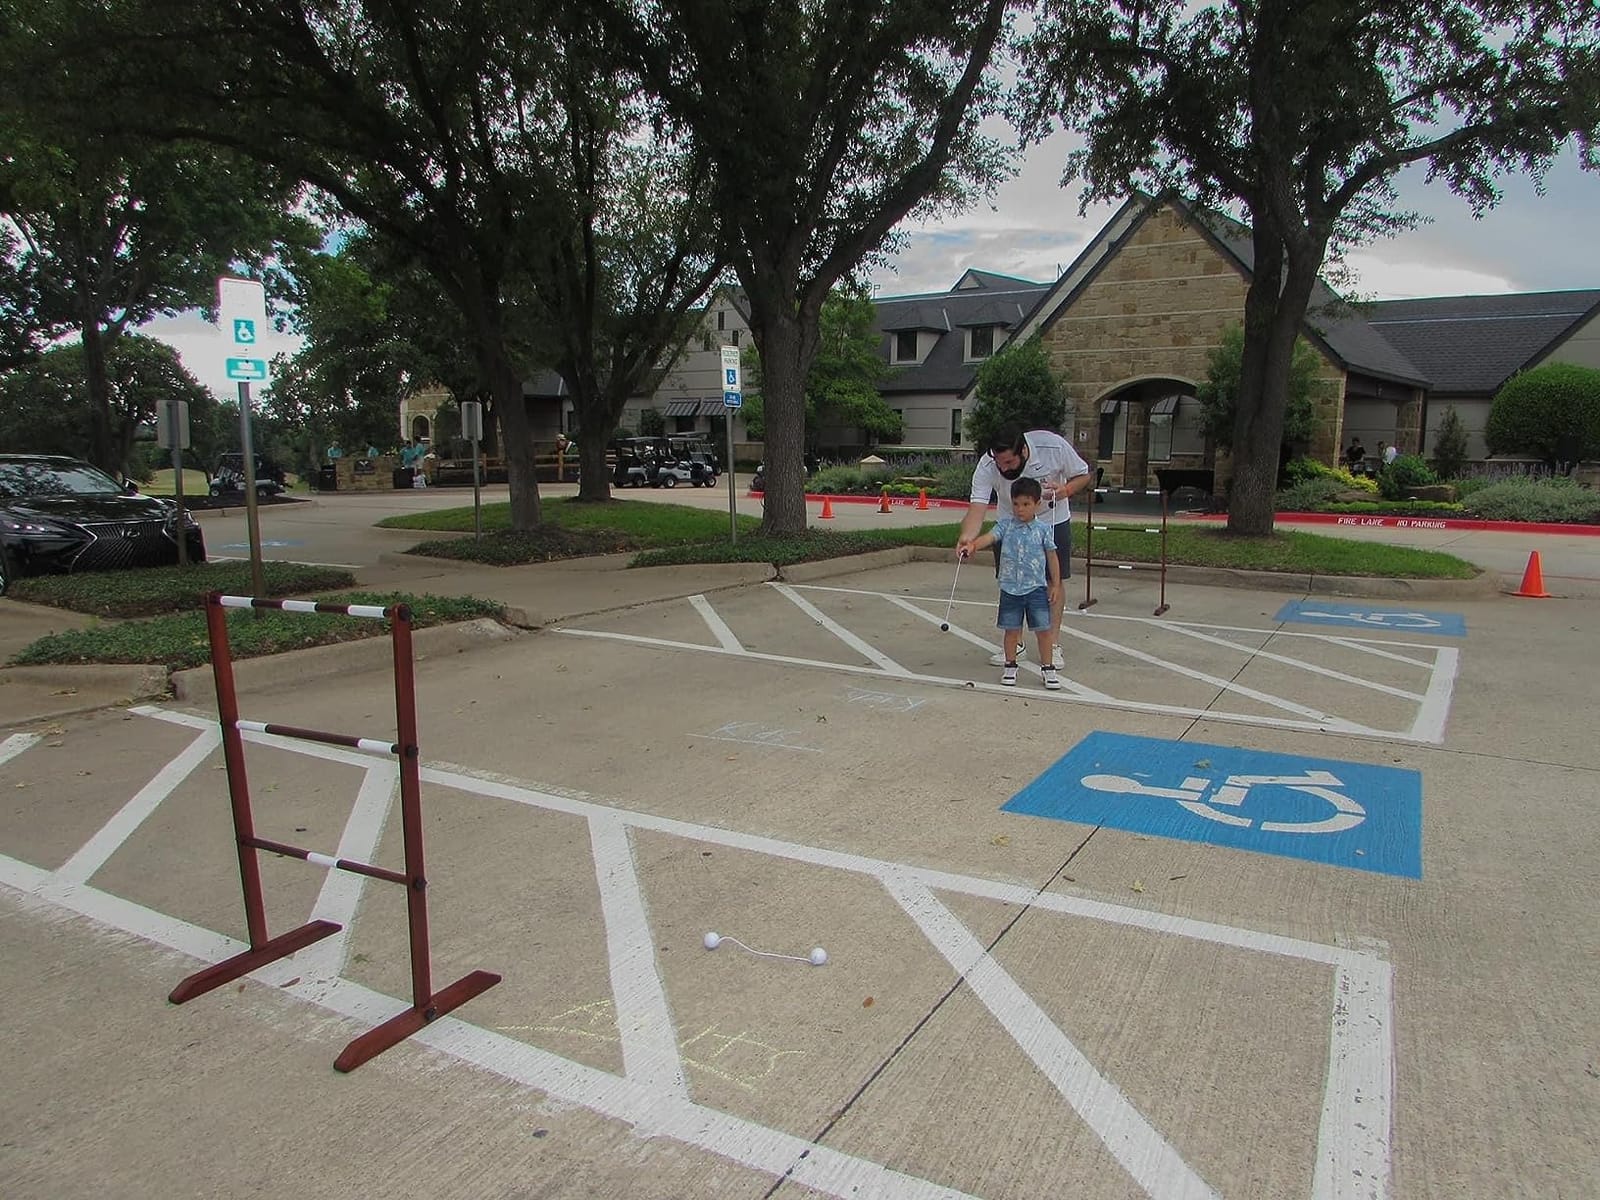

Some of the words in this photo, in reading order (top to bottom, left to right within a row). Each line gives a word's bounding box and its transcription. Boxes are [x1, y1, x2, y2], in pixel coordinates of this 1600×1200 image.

[1337, 517, 1357, 526] FIRE
[1361, 518, 1384, 527] LANE
[1396, 520, 1409, 528] NO
[1411, 520, 1446, 529] PARKING
